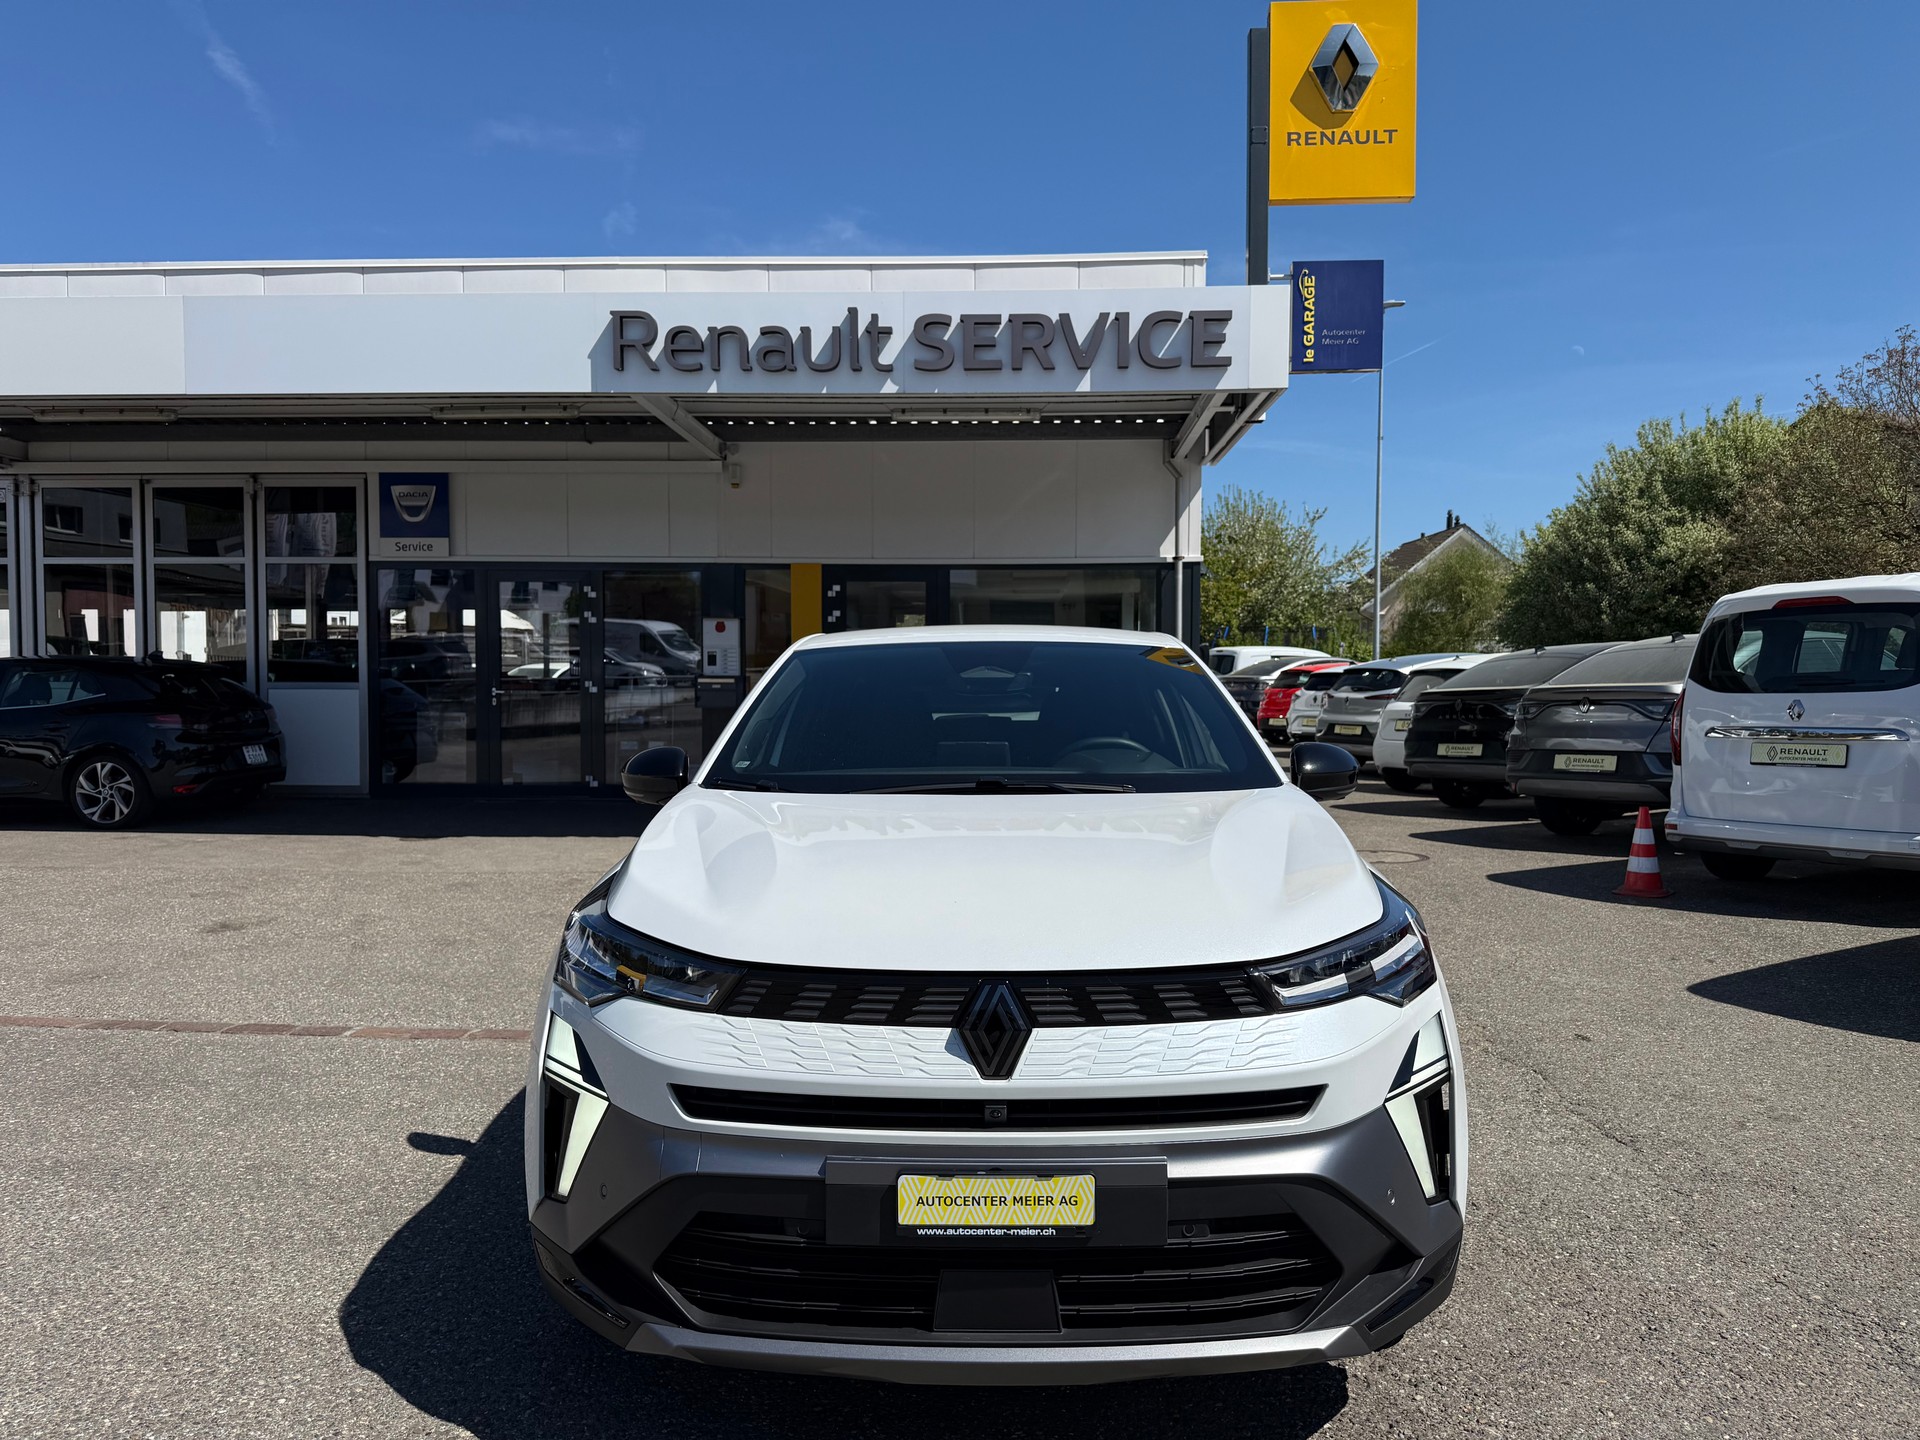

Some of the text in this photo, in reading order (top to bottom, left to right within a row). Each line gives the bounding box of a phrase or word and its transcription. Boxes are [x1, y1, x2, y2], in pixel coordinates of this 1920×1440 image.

[1286, 129, 1398, 146] RENAULT
[1303, 275, 1316, 363] le GARAGE
[609, 307, 1232, 372] Renault SERVICE
[394, 541, 434, 552] Service
[1780, 748, 1828, 756] RENAULT
[916, 1195, 1078, 1207] AUTOCENTER MEIER AG
[916, 1227, 1056, 1236] www.autocenter-meier.ch
